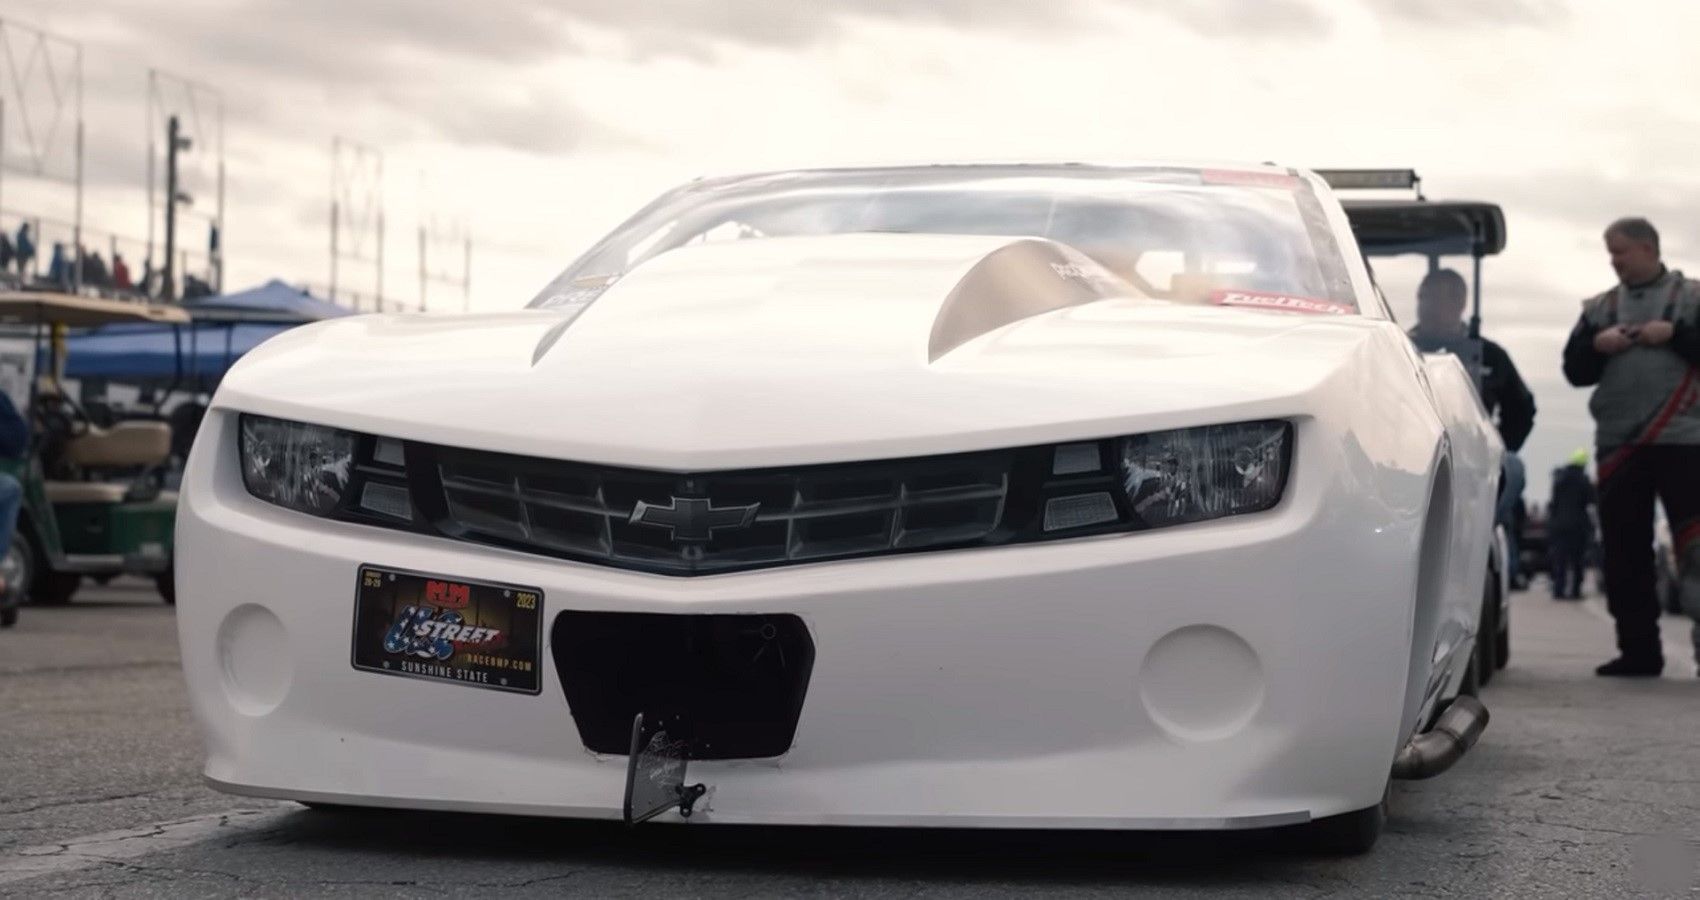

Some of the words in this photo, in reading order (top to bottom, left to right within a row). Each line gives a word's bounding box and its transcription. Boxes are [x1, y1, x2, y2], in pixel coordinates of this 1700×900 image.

[516, 592, 536, 609] 2023
[415, 620, 500, 643] STREET
[401, 661, 452, 678] SUNSHINE
[457, 668, 488, 683] STATE
